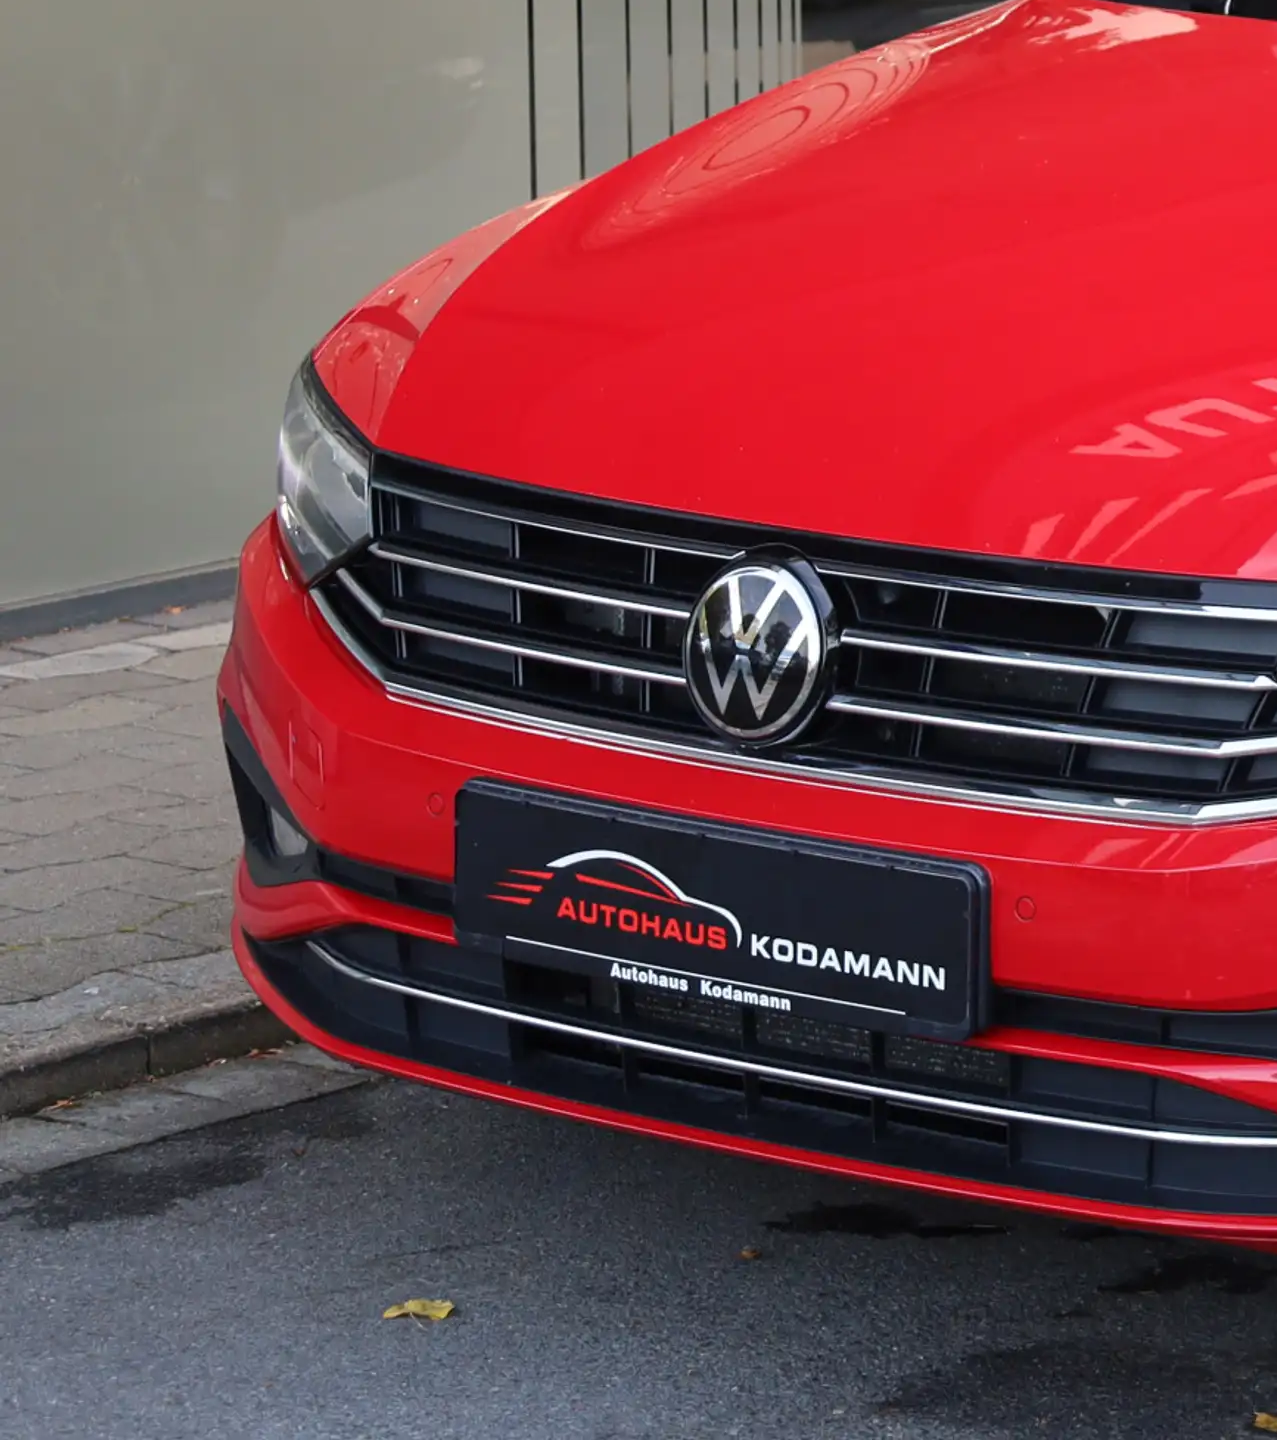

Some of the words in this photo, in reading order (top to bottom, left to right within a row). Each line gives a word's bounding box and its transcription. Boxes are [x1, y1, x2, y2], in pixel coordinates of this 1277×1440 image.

[556, 896, 728, 950] AUTOHAUS
[751, 933, 946, 992] KODAMANN
[610, 962, 689, 993] Autohaus
[700, 979, 791, 1012] Kodamann
